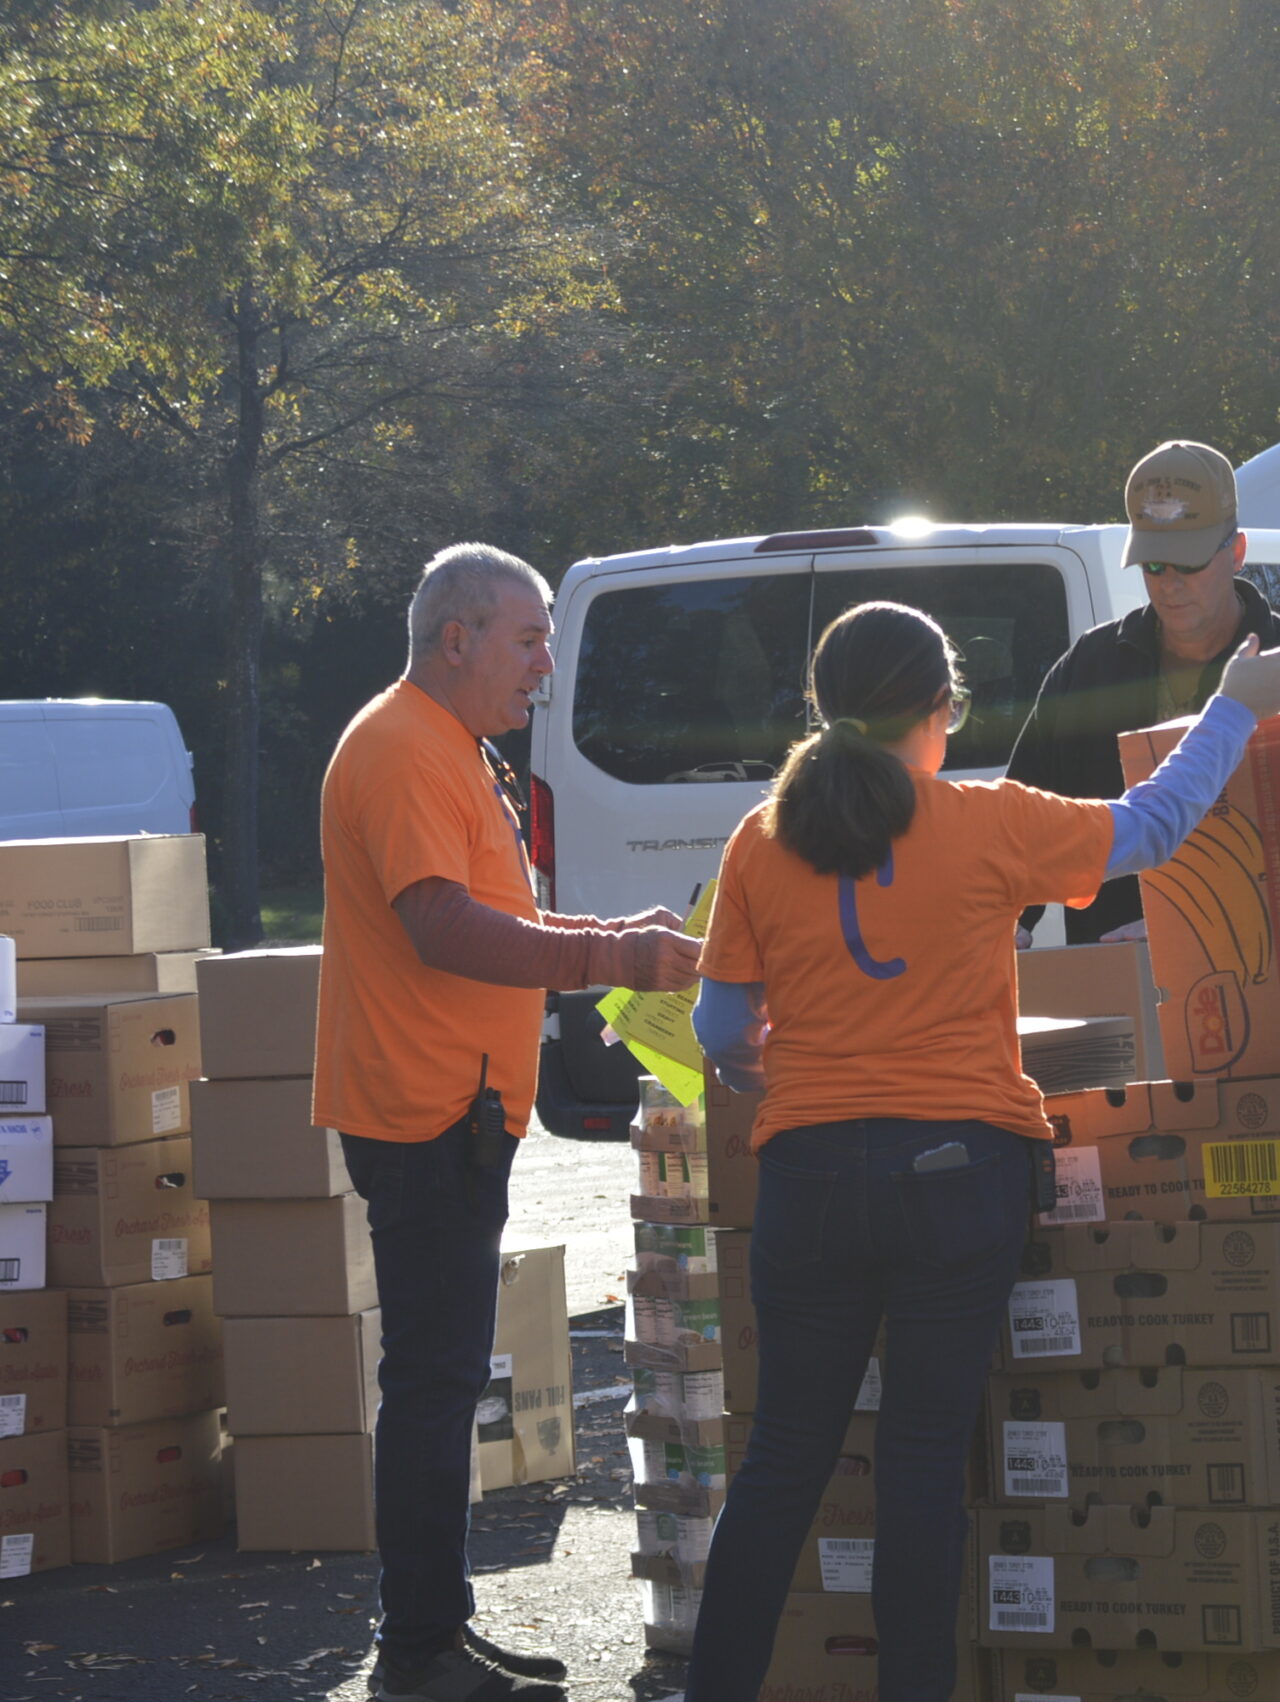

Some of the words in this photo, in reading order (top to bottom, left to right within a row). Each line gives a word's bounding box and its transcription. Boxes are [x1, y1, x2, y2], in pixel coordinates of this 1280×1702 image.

[1193, 985, 1226, 1056] Dole
[1107, 1184, 1141, 1199] READY
[1143, 1183, 1157, 1195] TO
[1160, 1180, 1190, 1193] COOK
[1220, 1182, 1271, 1195] 22564278
[1014, 1318, 1044, 1331] 1443
[1087, 1315, 1122, 1329] READY
[1138, 1313, 1169, 1327] COOK
[1172, 1312, 1216, 1326] TURKEY
[514, 1389, 543, 1411] PANS
[546, 1384, 565, 1406] FOIL
[1119, 1464, 1149, 1478] COOK
[1151, 1463, 1193, 1476] TURKEY
[822, 1502, 876, 1528] Fresh
[993, 1590, 1021, 1604] 1443
[1060, 1600, 1093, 1614] READY
[1095, 1600, 1109, 1614] TO
[1112, 1601, 1144, 1615] COOK
[1146, 1602, 1187, 1616] TURKEY
[760, 1682, 829, 1702] rchard
